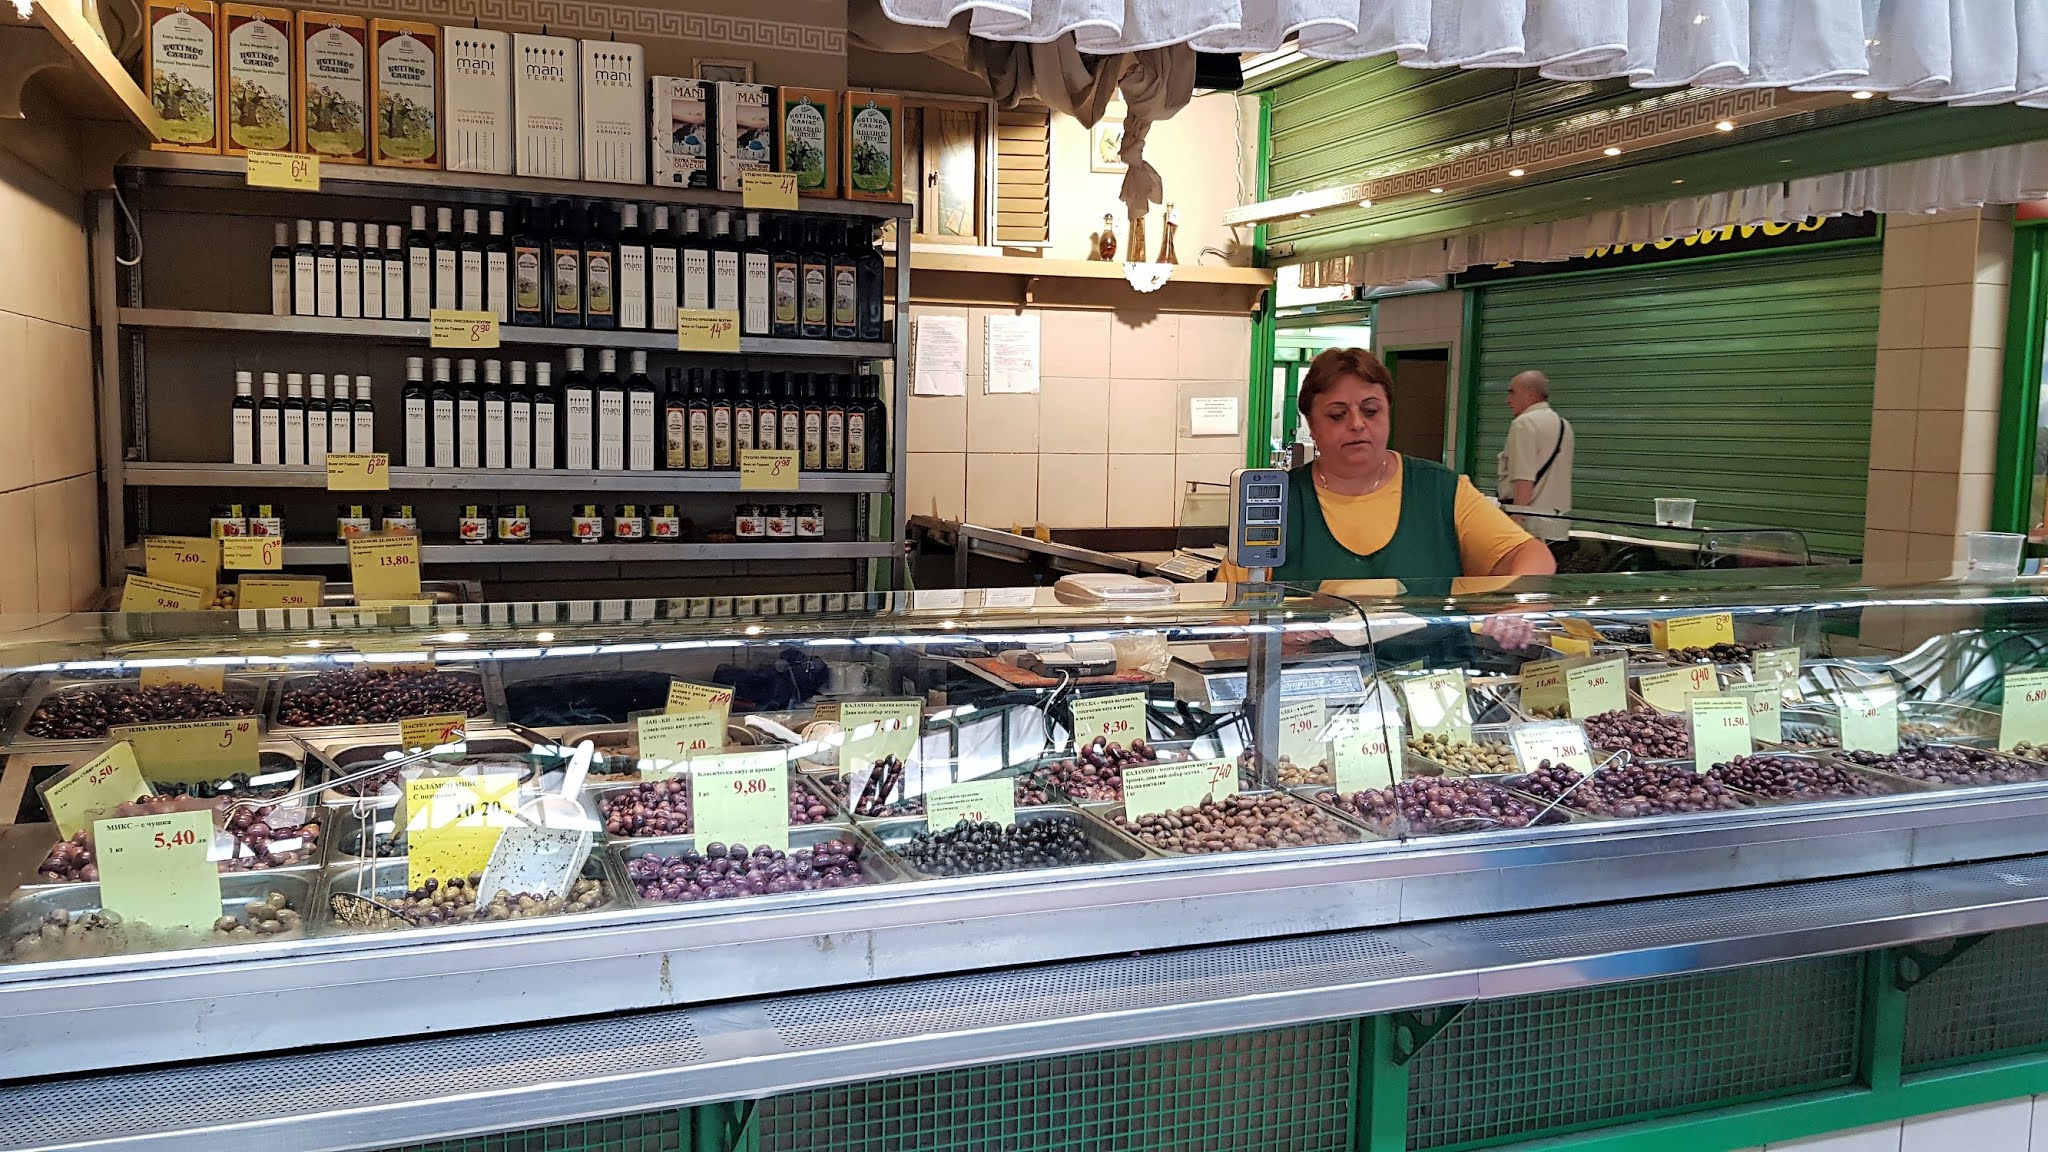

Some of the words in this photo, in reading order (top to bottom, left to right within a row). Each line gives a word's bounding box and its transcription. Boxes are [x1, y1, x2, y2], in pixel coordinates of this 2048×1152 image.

[456, 58, 494, 70] mani
[457, 67, 496, 77] TERRA
[526, 64, 563, 76] mani
[595, 70, 631, 81] mani
[527, 74, 564, 82] TERRA
[596, 79, 632, 88] TERRA
[673, 87, 703, 98] MANI
[737, 93, 767, 104] MANI
[291, 160, 308, 178] 64
[780, 178, 795, 194] 41
[174, 552, 199, 563] 7,60
[380, 555, 409, 566] 13,80
[157, 598, 179, 609] 9,80
[1284, 677, 1325, 689] omputing
[1536, 677, 1556, 688] 11,80
[1588, 676, 1605, 688] 9,80
[2026, 689, 2047, 702] 6,80
[1860, 708, 1876, 718] 7,40
[1103, 719, 1128, 736] 8,30
[1290, 719, 1312, 734] 7,90
[1723, 717, 1744, 727] 11,50
[1361, 742, 1386, 757] 6,90
[1553, 745, 1577, 758] 7,80
[89, 764, 113, 787] 9,50
[1125, 768, 1155, 777] КАЛАМОН
[733, 778, 767, 796] 9,80
[106, 822, 133, 831] МИКС
[146, 820, 172, 829] чушка
[154, 829, 195, 850] 5,40
